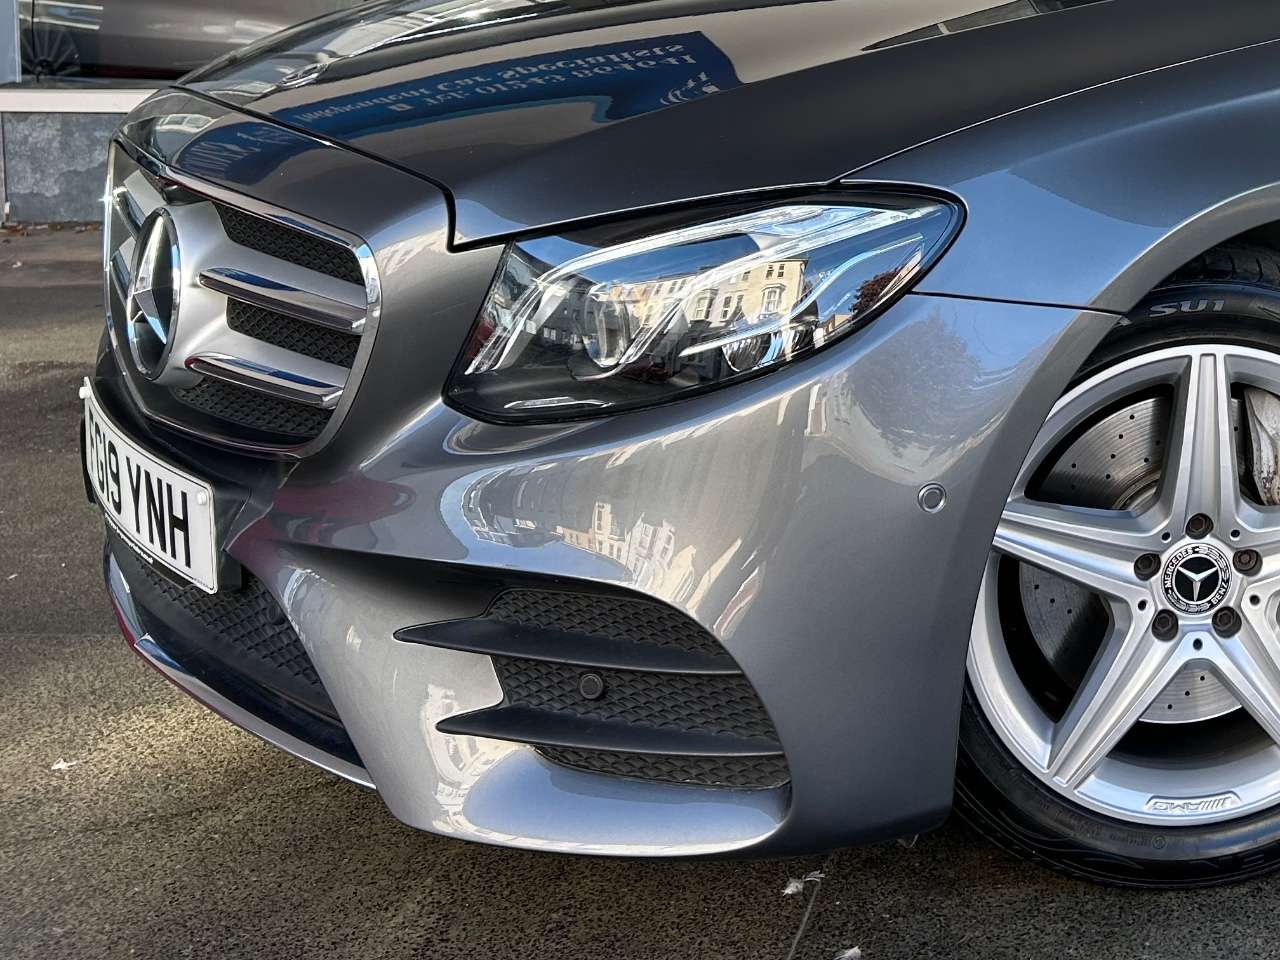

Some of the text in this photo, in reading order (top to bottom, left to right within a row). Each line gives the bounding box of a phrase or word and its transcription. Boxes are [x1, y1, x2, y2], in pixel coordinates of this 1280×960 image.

[126, 456, 191, 569] YNH
[1164, 547, 1194, 589] MERCEDES
[1210, 581, 1229, 605] BENZ
